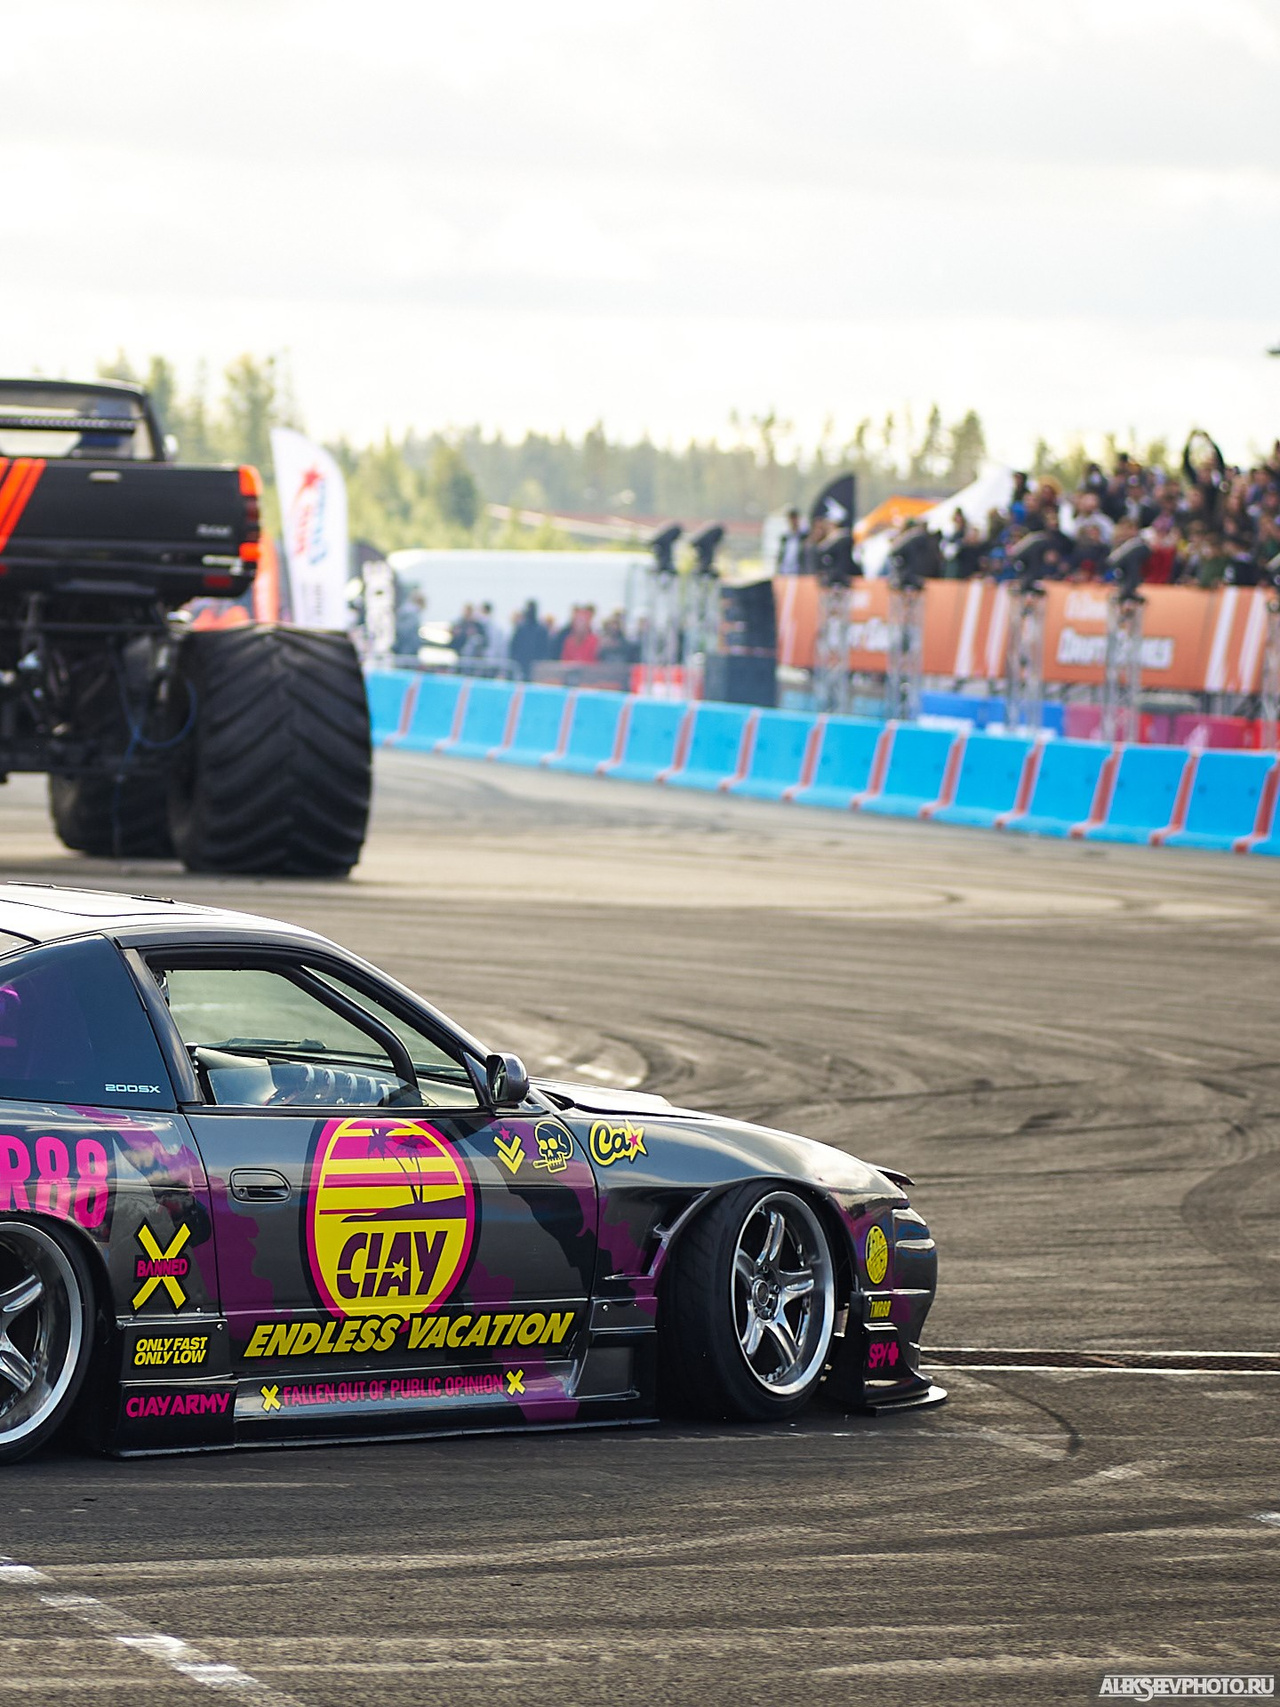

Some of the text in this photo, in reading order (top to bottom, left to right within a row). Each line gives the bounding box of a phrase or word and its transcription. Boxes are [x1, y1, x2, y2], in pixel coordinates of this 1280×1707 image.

[104, 1084, 161, 1094] 200SX
[136, 1258, 188, 1277] BANNED
[243, 1311, 575, 1358] ENDLESS VACATION
[136, 1336, 208, 1352] ONLY FAST
[134, 1349, 207, 1365] ONLY LOW
[283, 1383, 335, 1406] FALLEN
[337, 1381, 367, 1403] OUT
[369, 1379, 388, 1401] OF
[390, 1376, 441, 1399] PUBLIC
[444, 1373, 504, 1396] OPINION
